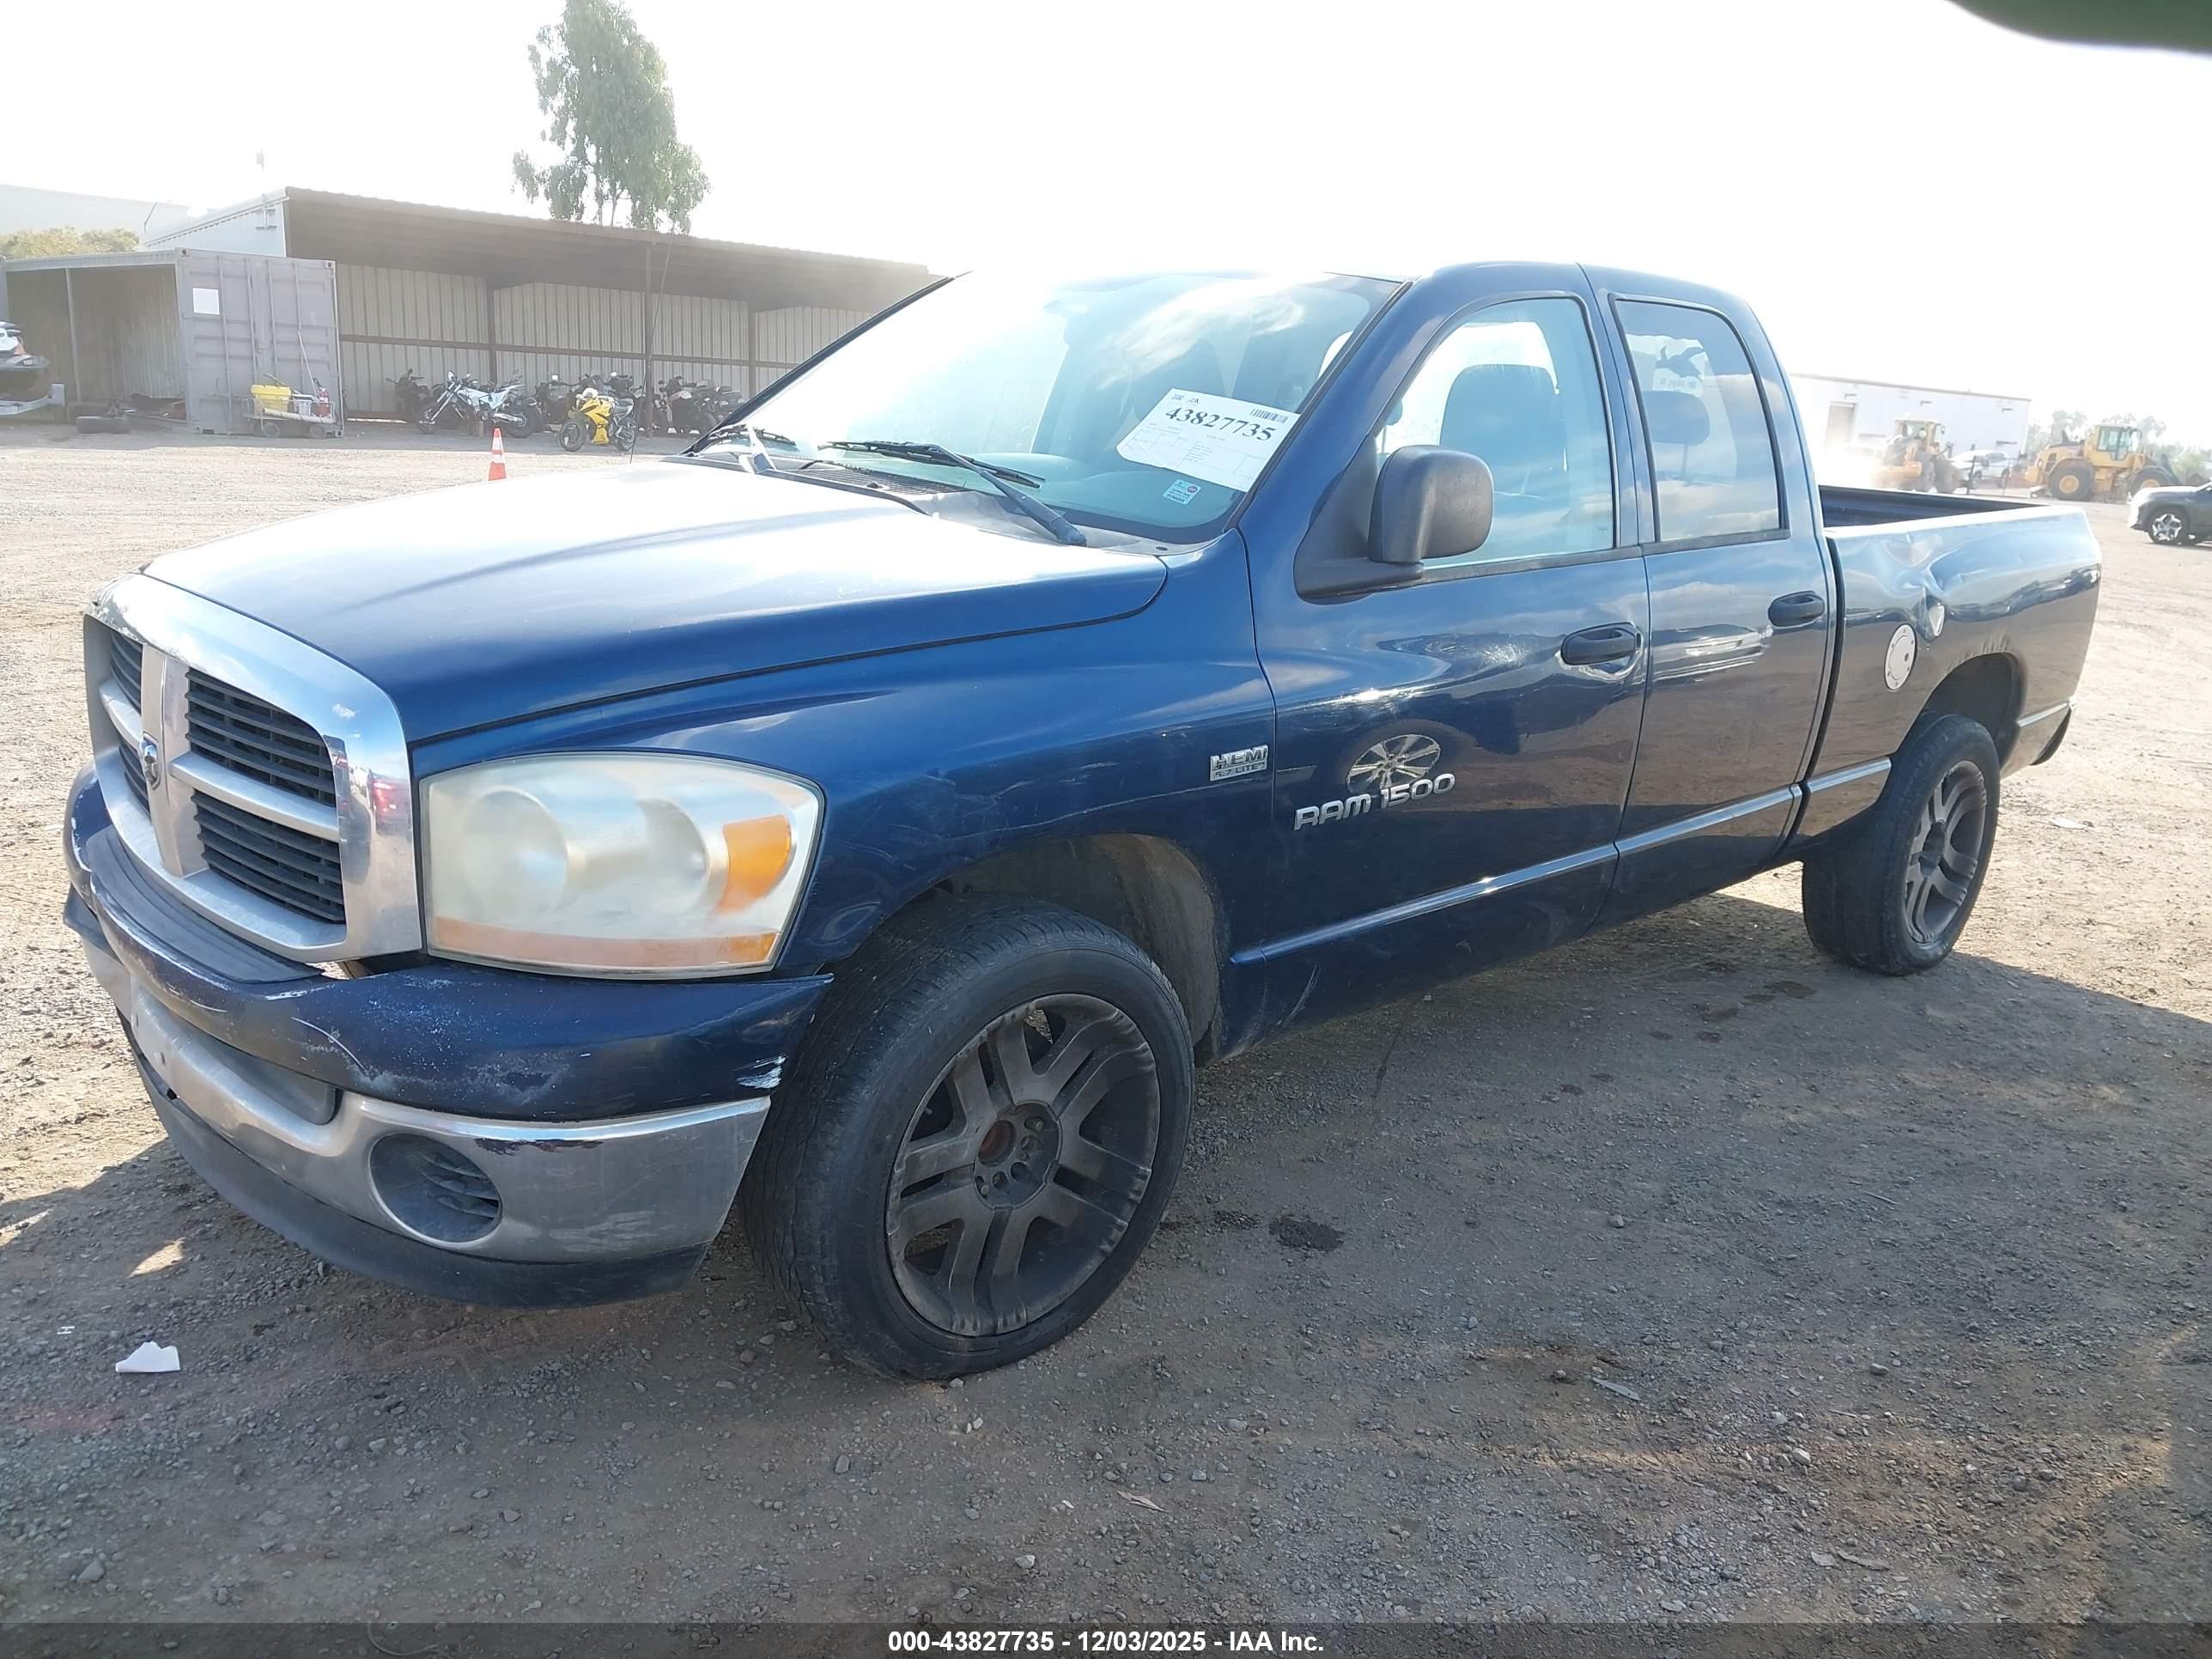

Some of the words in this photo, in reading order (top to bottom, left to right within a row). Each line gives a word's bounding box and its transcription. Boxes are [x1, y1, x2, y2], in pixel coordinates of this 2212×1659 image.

[1165, 407, 1276, 441] 43827735
[1211, 745, 1267, 769] HEMI
[1294, 793, 1371, 831] RAM
[1380, 773, 1455, 809] 1500
